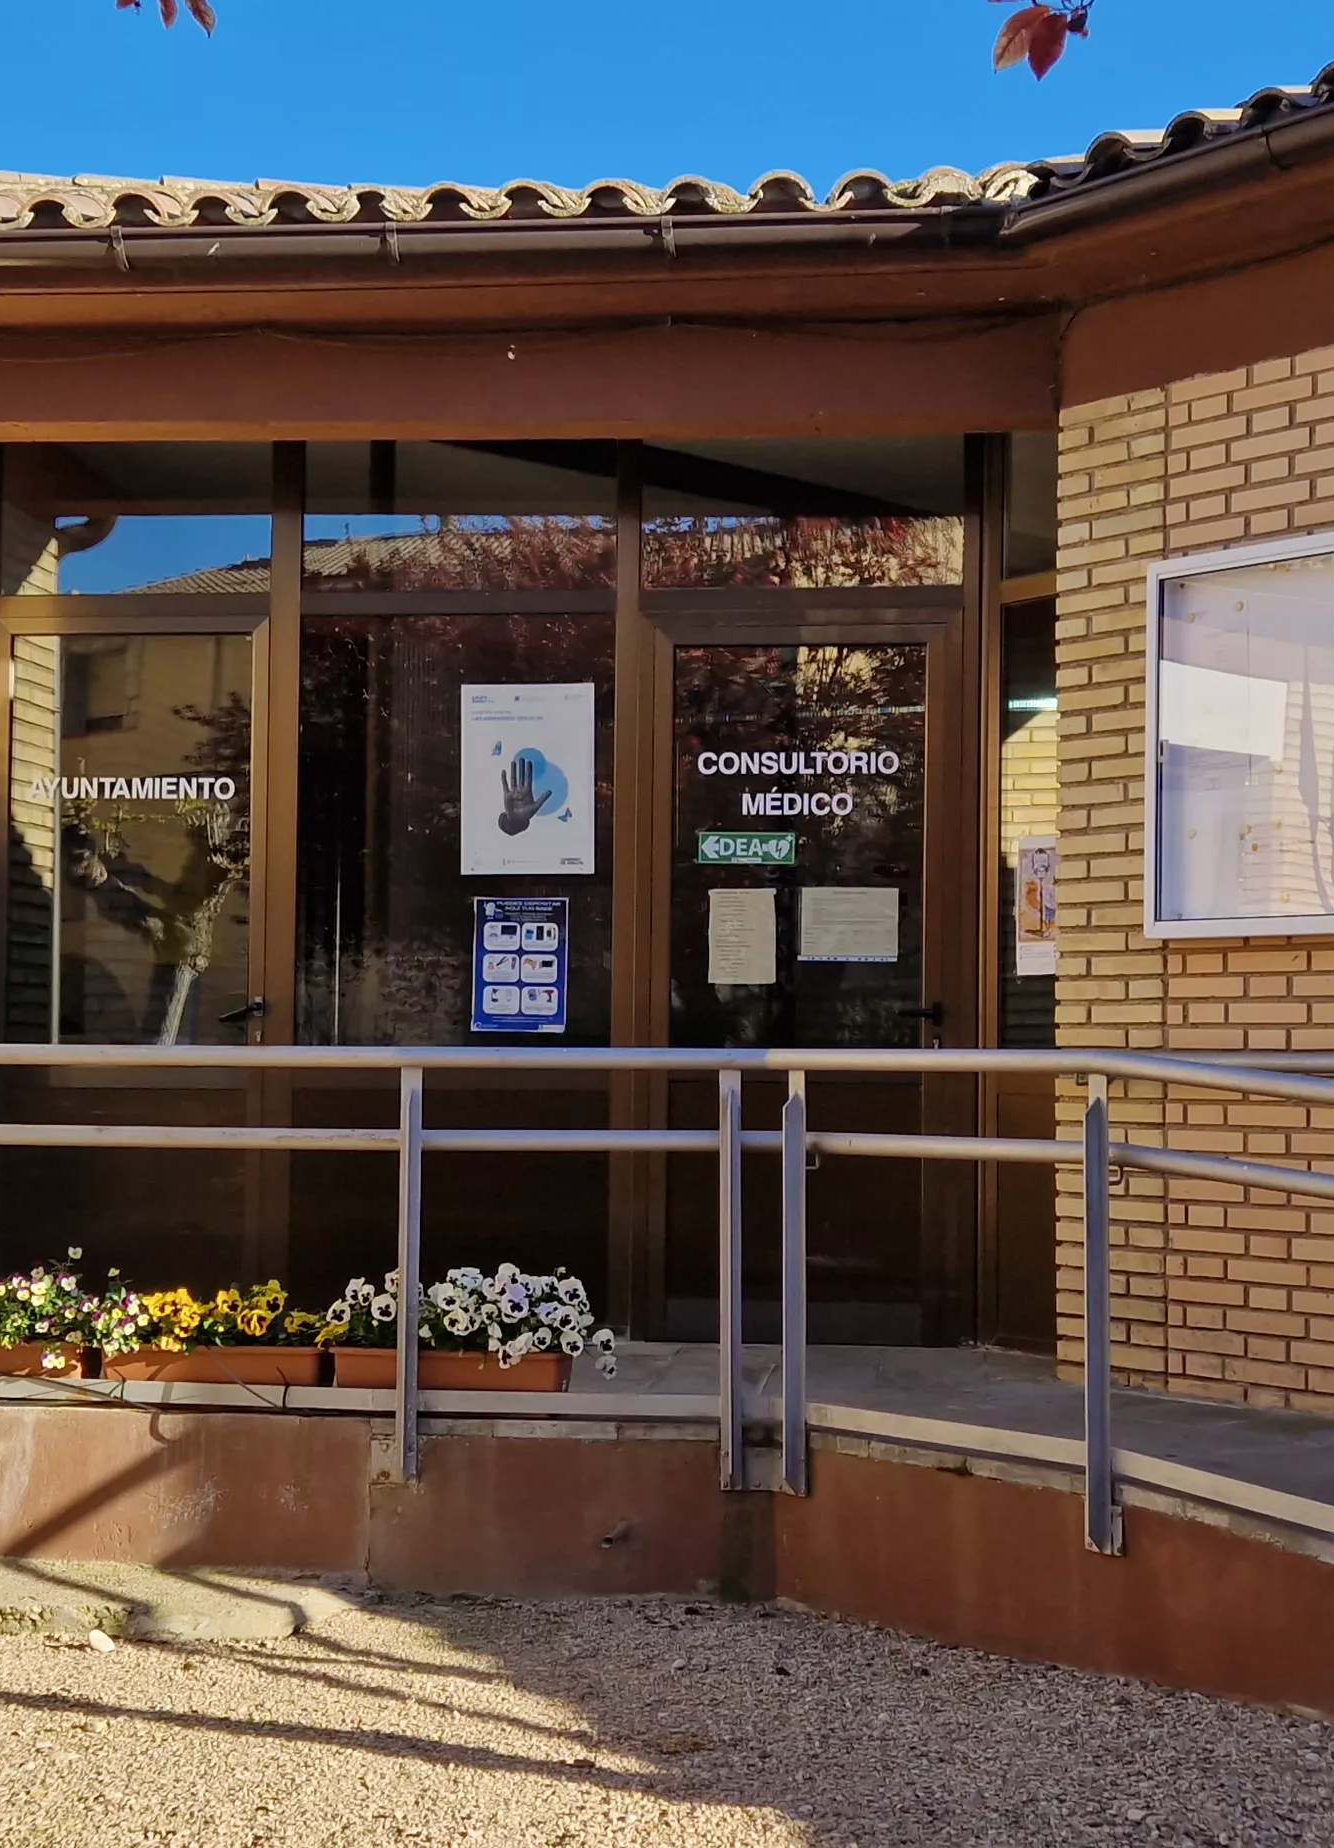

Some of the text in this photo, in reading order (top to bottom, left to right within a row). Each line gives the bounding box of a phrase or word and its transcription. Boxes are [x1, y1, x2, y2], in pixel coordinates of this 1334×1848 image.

[697, 751, 900, 776] CONSULTORIO
[30, 776, 236, 800] AYUNTAMIENTO
[741, 786, 854, 816] MÉDICO
[719, 838, 764, 857] DEA
